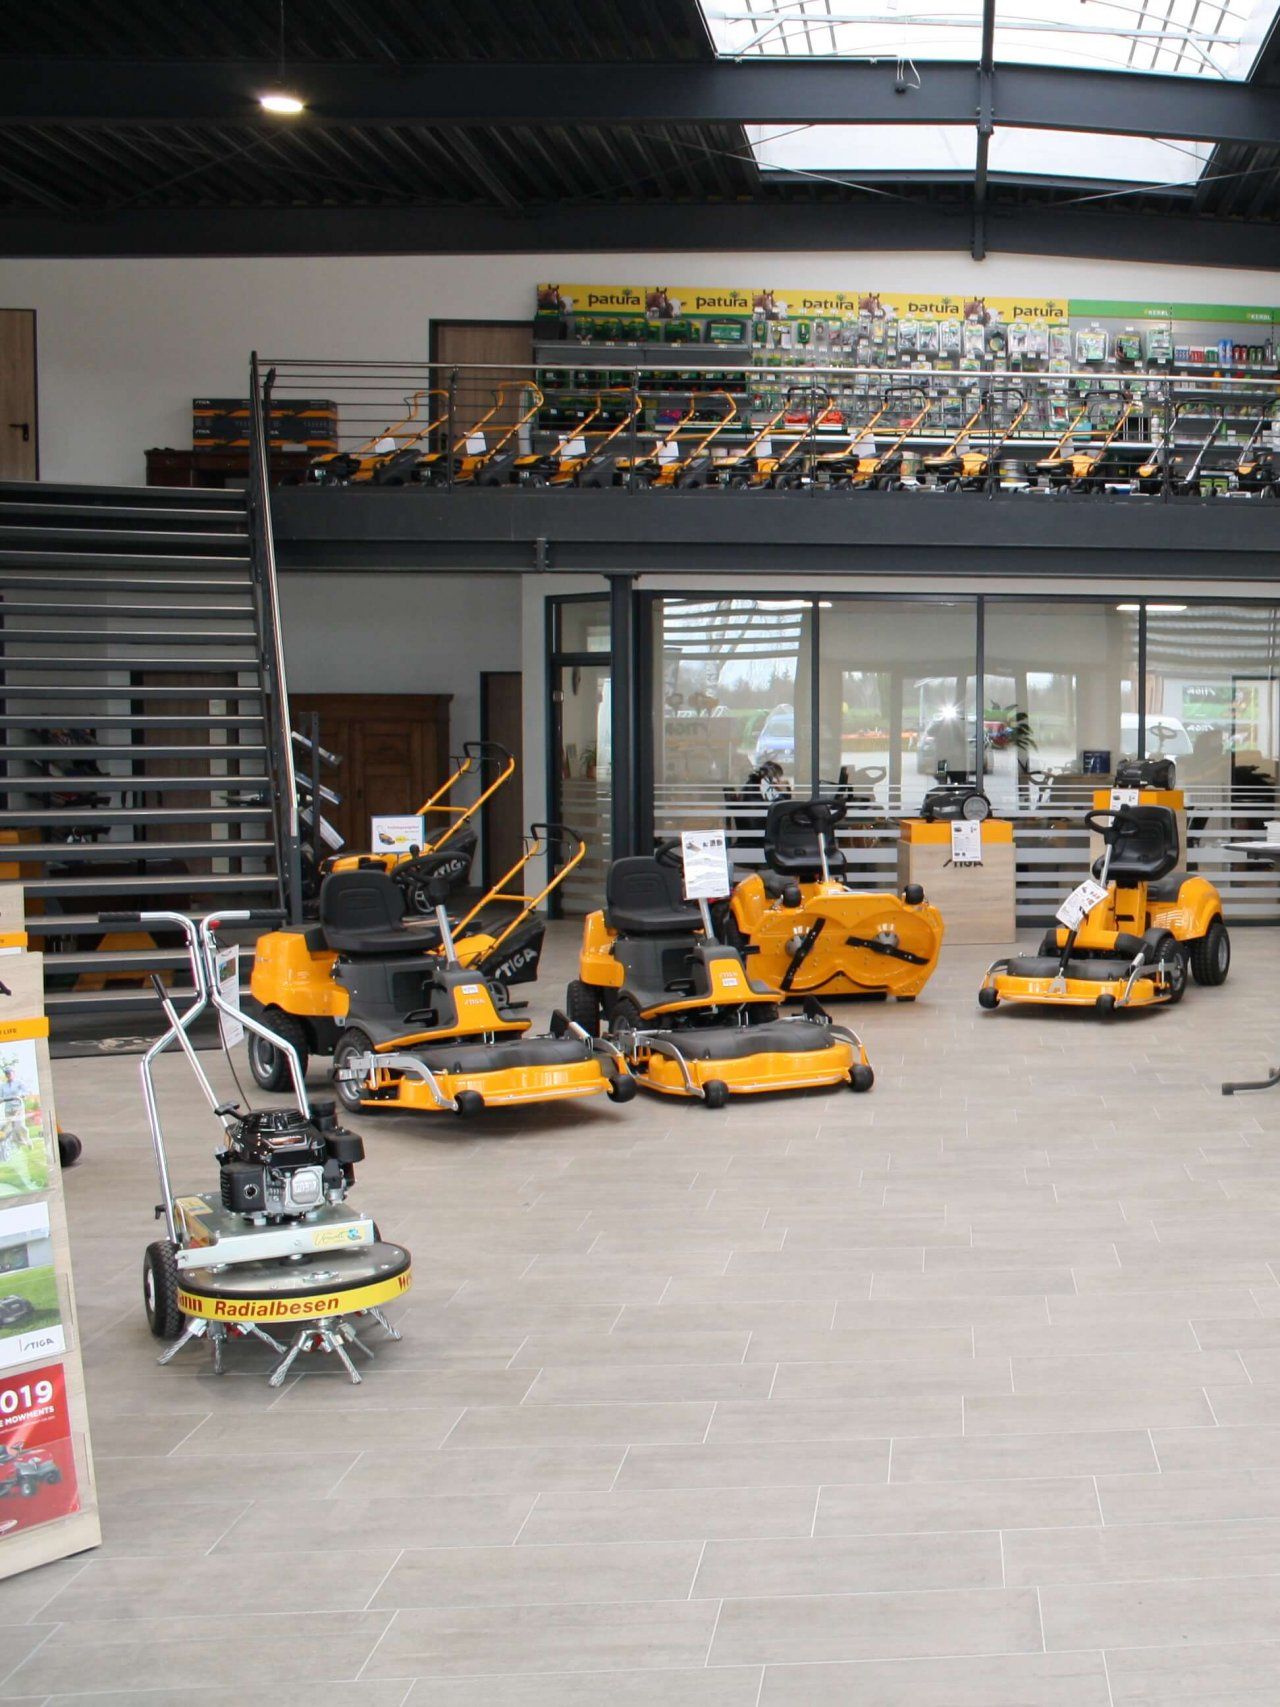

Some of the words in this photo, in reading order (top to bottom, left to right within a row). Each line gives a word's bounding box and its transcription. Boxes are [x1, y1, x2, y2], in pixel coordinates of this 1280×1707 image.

[587, 292, 641, 307] patura
[695, 294, 748, 309] patura
[1013, 306, 1064, 318] patura
[495, 948, 538, 979] STIGA
[214, 1297, 339, 1317] Radialbesen
[24, 1338, 55, 1352] STIGA
[0, 1380, 53, 1414] 019
[4, 1405, 55, 1425] MOWMENTS
